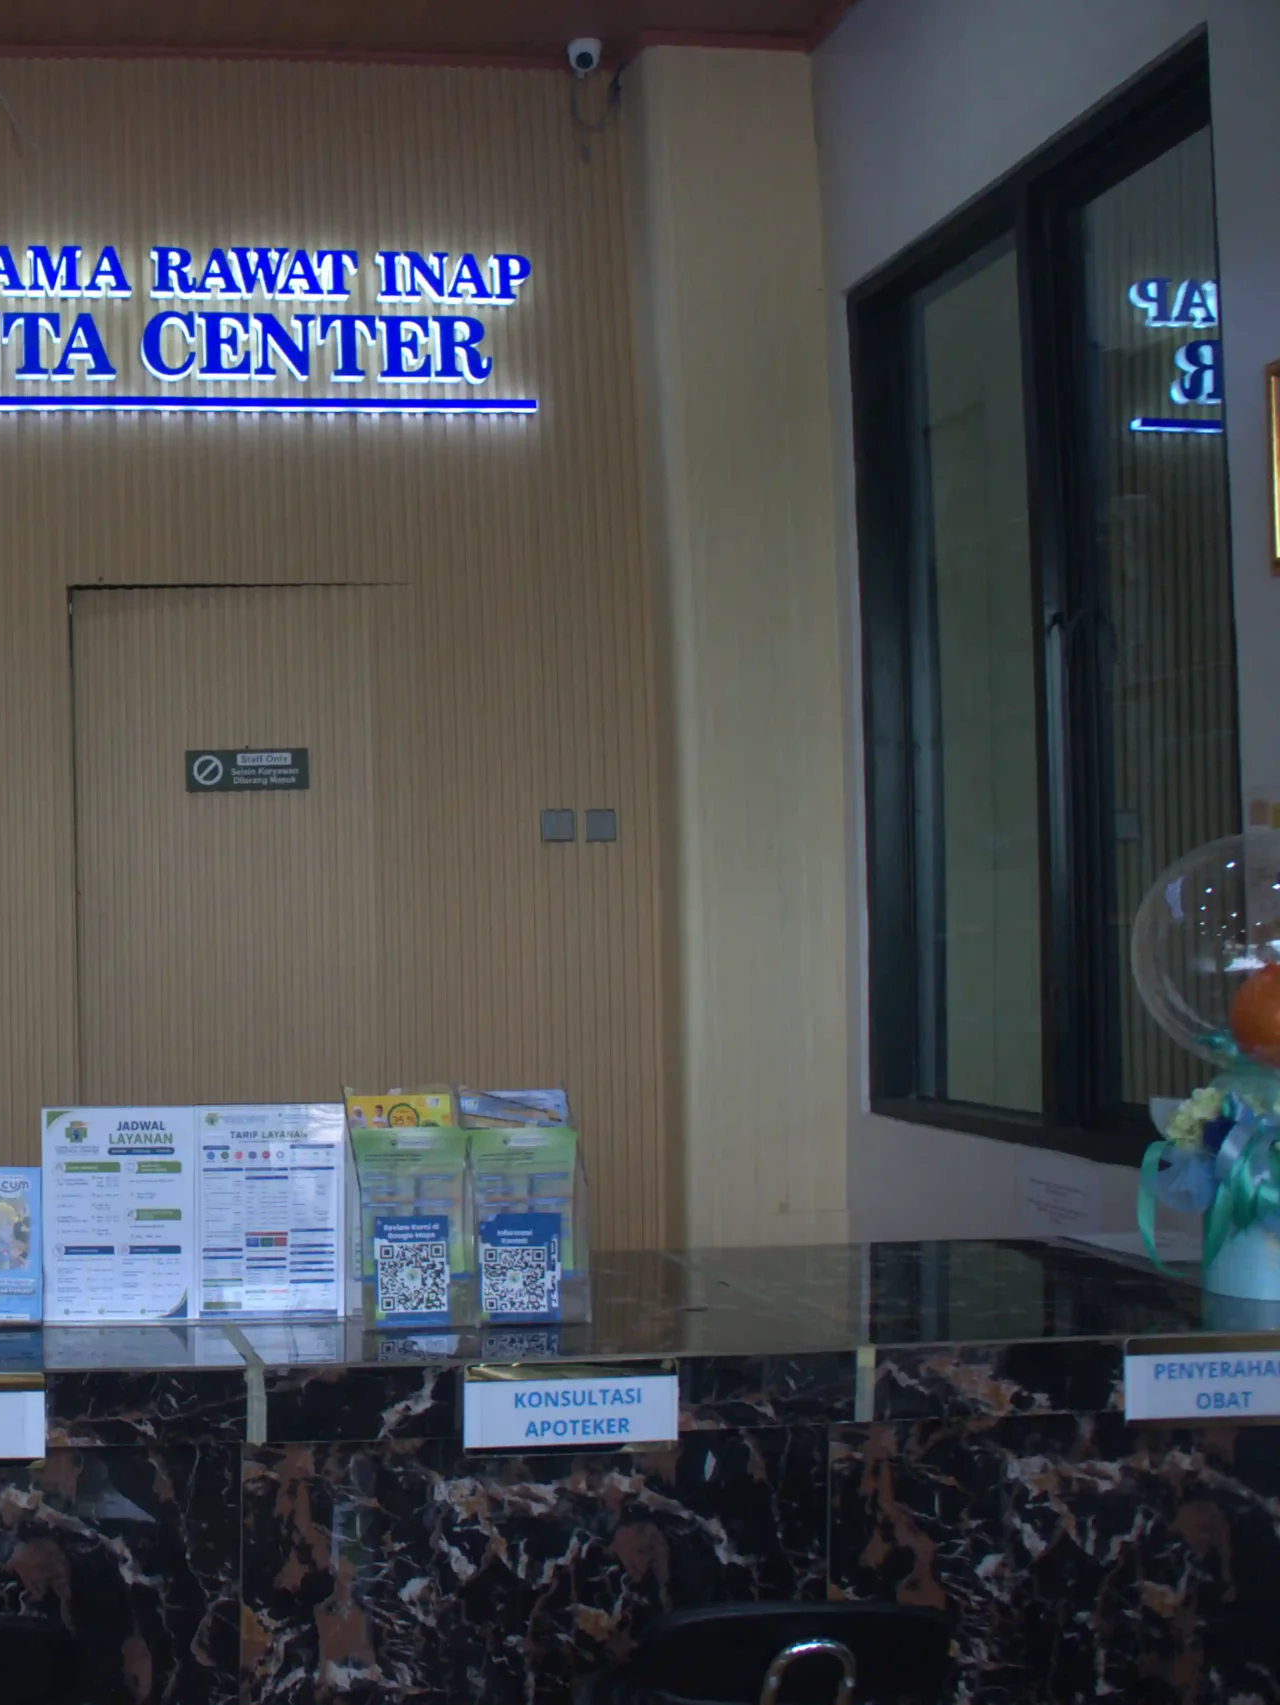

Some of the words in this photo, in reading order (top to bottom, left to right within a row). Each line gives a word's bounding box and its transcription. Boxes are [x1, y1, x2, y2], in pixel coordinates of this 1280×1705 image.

[149, 246, 359, 302] RAWAT
[375, 251, 532, 306] INAP
[140, 311, 493, 385] CENTER
[241, 755, 263, 764] Staff
[266, 754, 289, 764] Only
[231, 768, 256, 776] Selain
[258, 767, 299, 776] Karyawan
[233, 776, 268, 785] Dilarang
[116, 1120, 166, 1132] JADWAL
[109, 1132, 173, 1145] LAYANAN
[230, 1131, 258, 1139] TARIF
[1154, 1359, 1280, 1380] PENYERAHA
[514, 1387, 642, 1408] KONSULTASI
[1196, 1391, 1253, 1410] OBAT
[525, 1417, 630, 1437] APOTEKER
